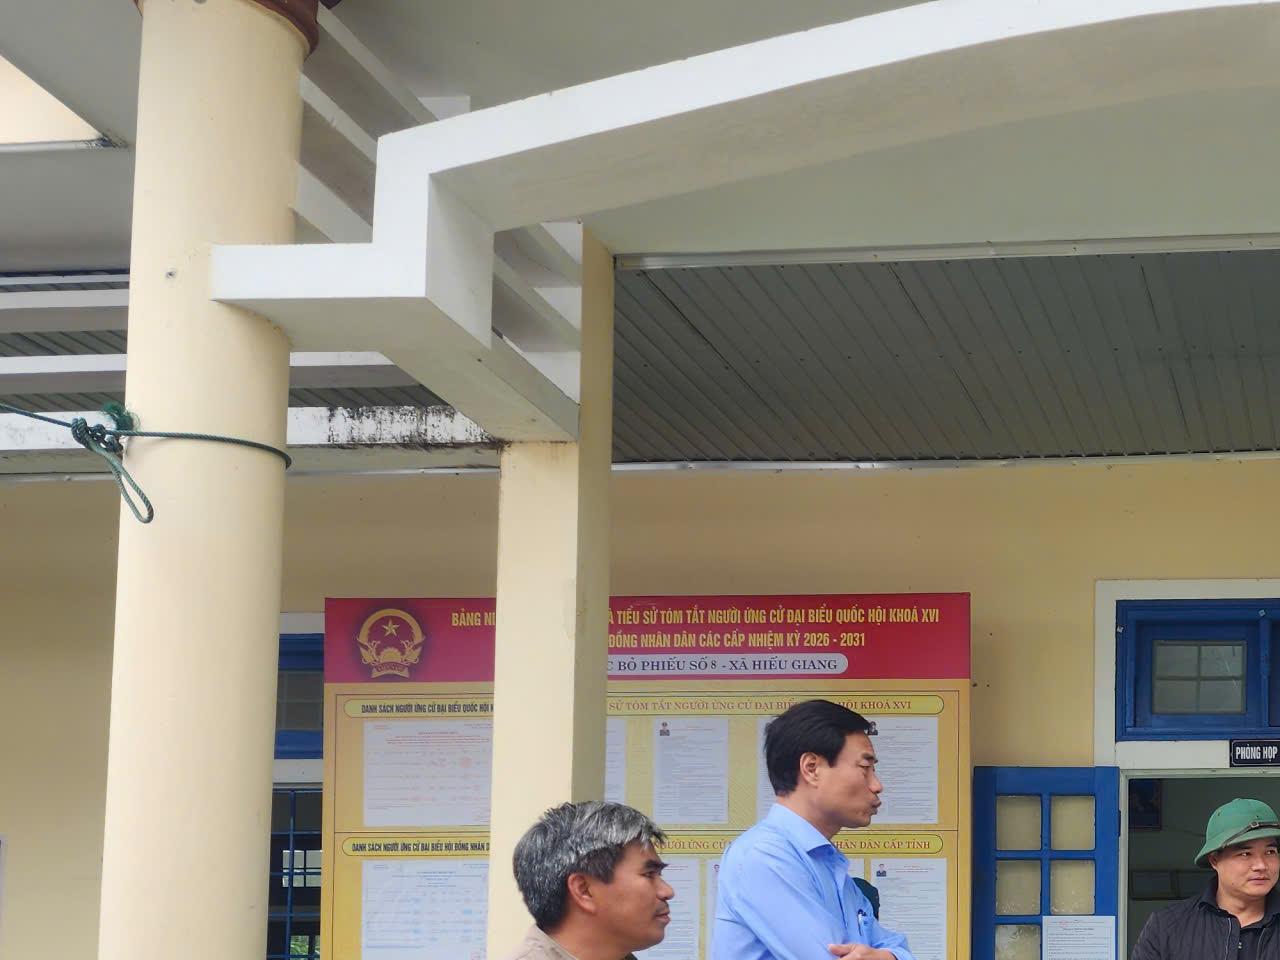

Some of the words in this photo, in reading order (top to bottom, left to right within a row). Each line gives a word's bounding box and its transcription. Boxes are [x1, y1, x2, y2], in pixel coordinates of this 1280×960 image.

[451, 608, 481, 626] BẢNG
[484, 611, 496, 626] NI
[617, 605, 639, 624] TIỂU
[642, 606, 658, 624] SỬ
[660, 607, 683, 624] TÓM
[686, 605, 704, 624] TẮT
[708, 607, 741, 624] NGƯỜI
[744, 606, 766, 624] ỨNG
[769, 605, 785, 623] CỬ
[787, 608, 804, 626] ĐẠI
[808, 603, 832, 623] BIỂU
[836, 604, 865, 624] QUỐC
[868, 606, 887, 626] HỘI
[921, 608, 939, 623] XVI
[608, 629, 637, 648] ĐỒNG
[640, 631, 670, 647] NHÂN
[674, 631, 696, 647] DÂN
[699, 630, 720, 647] CÁC
[723, 628, 745, 647] CẤP
[749, 631, 783, 650] NHIỆM
[787, 629, 801, 646] KỲ
[803, 632, 830, 647] 2026
[840, 632, 865, 647] 2031
[618, 657, 637, 671] BỎ
[641, 657, 686, 671] PHIẾU
[689, 655, 708, 671] SỐ
[710, 660, 717, 670] 8
[729, 657, 748, 670] XÃ
[752, 656, 788, 670] HIẾU
[791, 660, 837, 670] GIANG
[776, 698, 796, 710] BIỂ
[893, 701, 911, 710] XVI
[1235, 743, 1261, 759] PHÒNG
[1263, 746, 1278, 762] HỌP
[836, 839, 857, 849] HÂN
